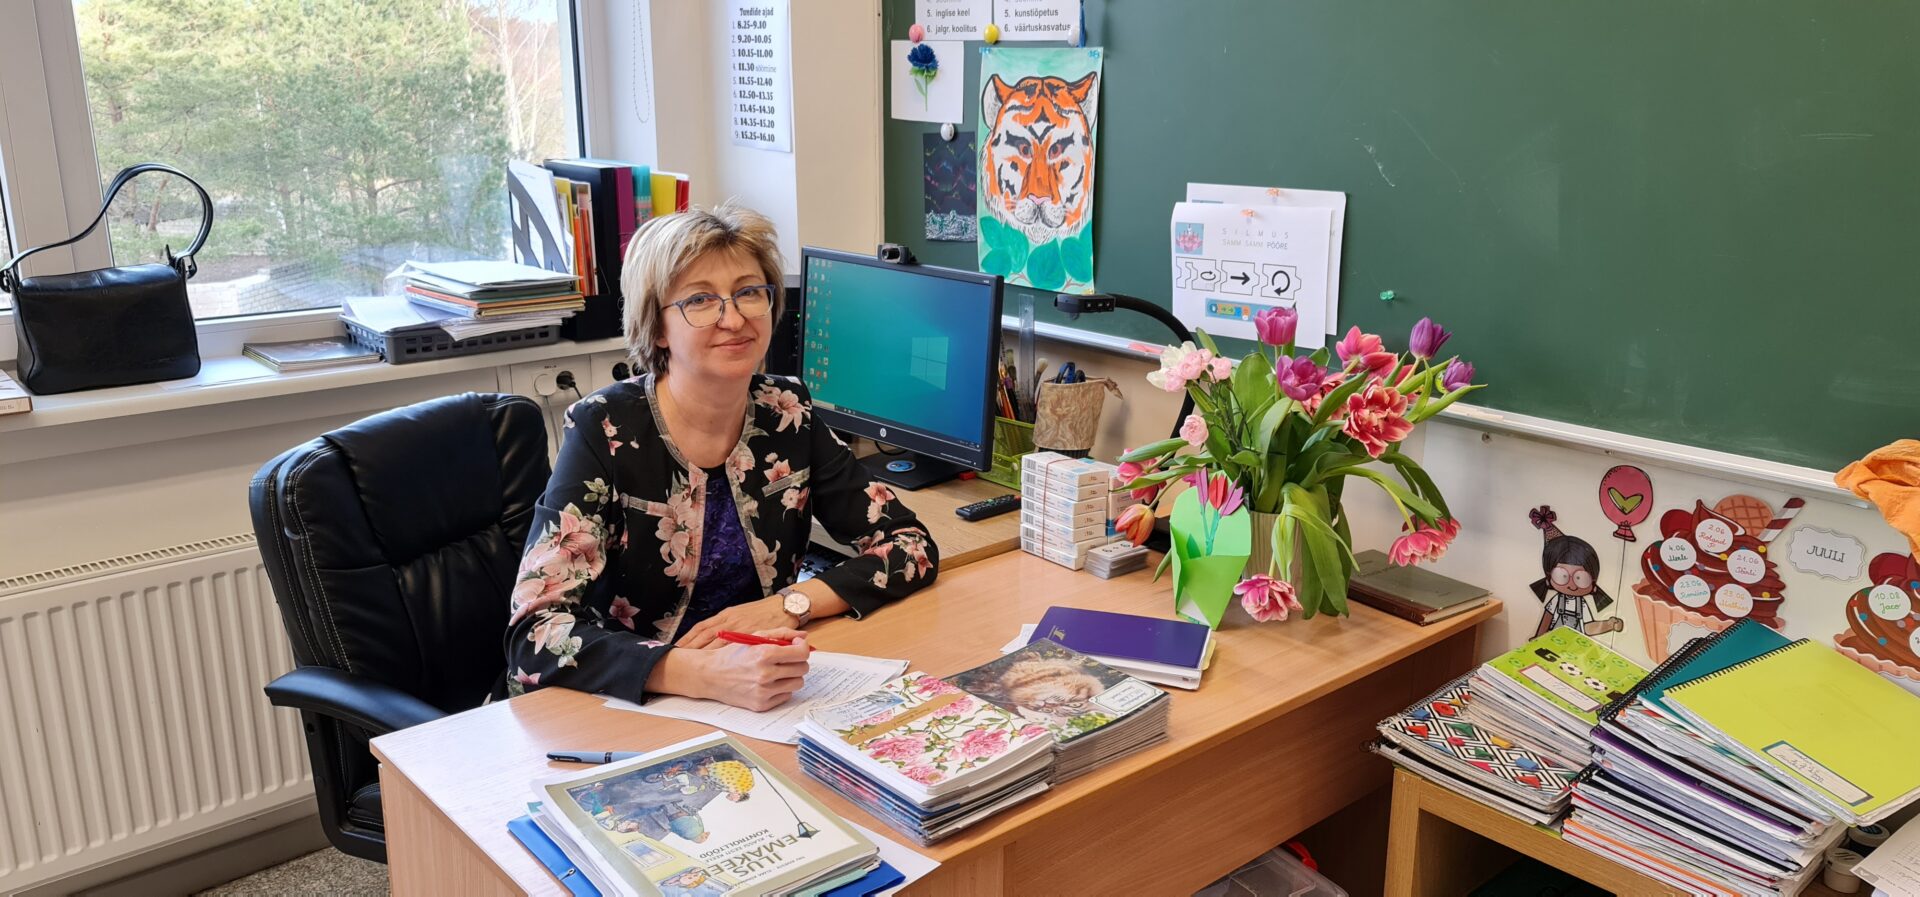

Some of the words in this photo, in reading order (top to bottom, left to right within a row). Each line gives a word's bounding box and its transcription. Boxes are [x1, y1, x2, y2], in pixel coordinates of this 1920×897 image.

[762, 7, 774, 18] ajad
[935, 8, 956, 19] inglise
[957, 7, 971, 16] keel
[952, 24, 977, 33] koolitus
[738, 62, 755, 71] 11.30
[1806, 544, 1846, 563] JUULI
[732, 852, 784, 878] ILUS
